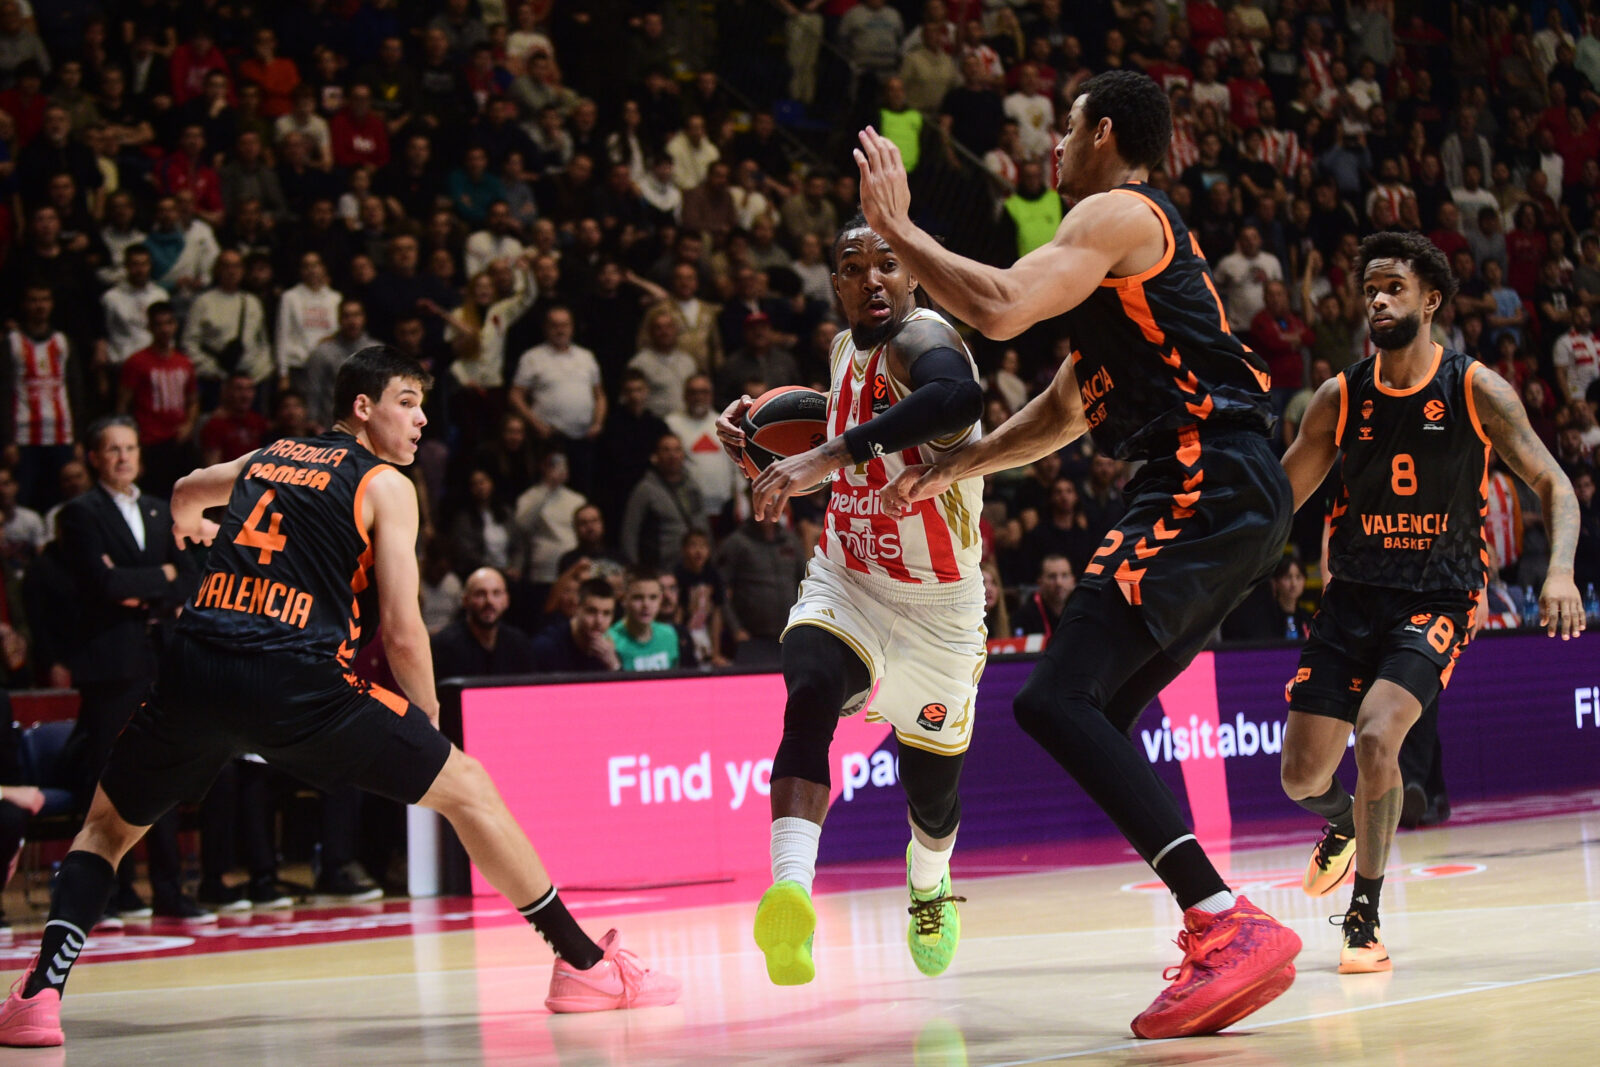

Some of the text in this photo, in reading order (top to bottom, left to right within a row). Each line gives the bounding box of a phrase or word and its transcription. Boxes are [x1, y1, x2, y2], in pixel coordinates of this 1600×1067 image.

[263, 439, 348, 467] PRADILLA
[1391, 453, 1418, 496] 8
[244, 463, 331, 491] PAMESA
[233, 488, 287, 565] 4
[836, 526, 901, 559] mts
[1383, 537, 1432, 551] BASKET
[1084, 529, 1124, 575] 2
[194, 572, 314, 630] VALENCIA
[1427, 615, 1455, 654] 8
[1141, 712, 1287, 763] visitabu
[607, 749, 900, 811] Find yo pa
